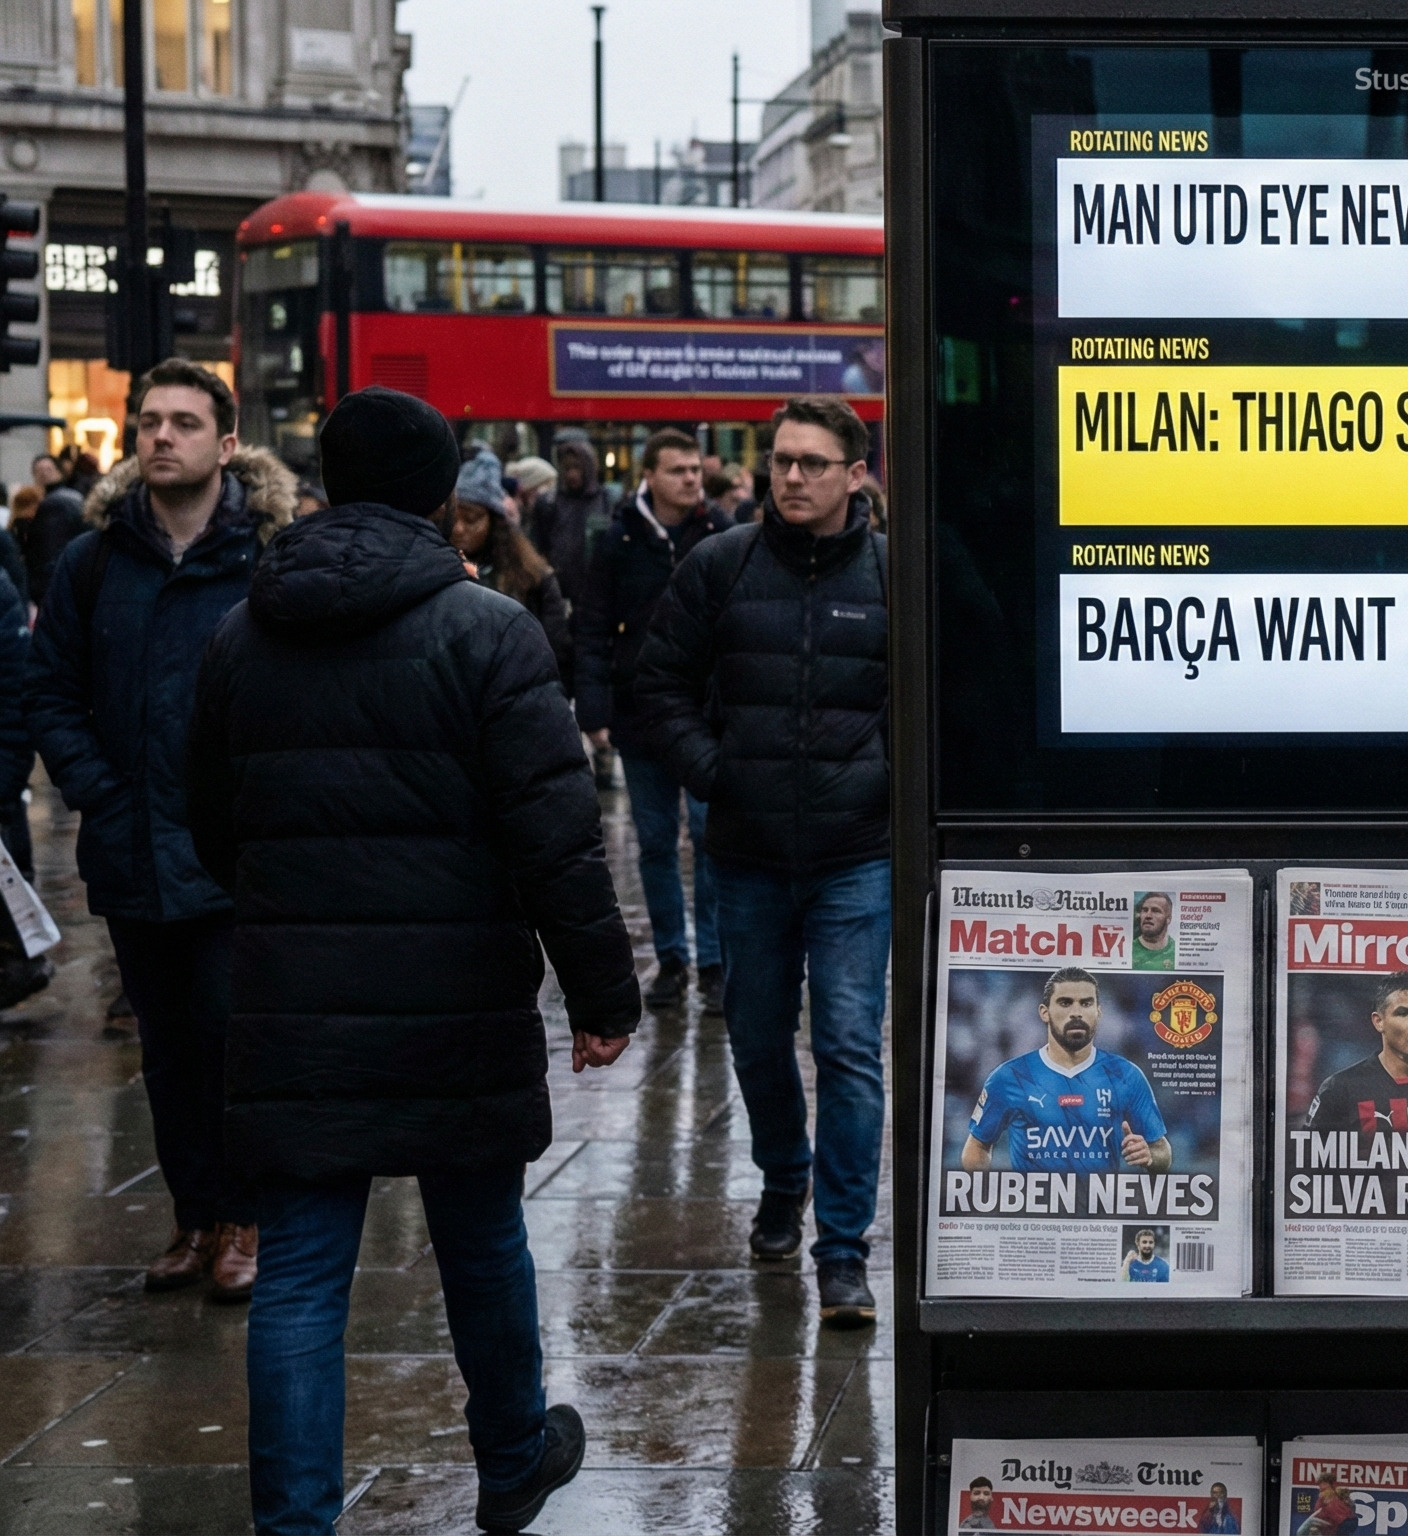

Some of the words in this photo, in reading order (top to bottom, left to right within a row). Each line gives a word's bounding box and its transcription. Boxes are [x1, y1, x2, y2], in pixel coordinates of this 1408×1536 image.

[1069, 130, 1154, 152] ROTATING
[1158, 130, 1209, 152] NEWS
[1072, 183, 1161, 246] MAN
[1173, 183, 1249, 246] UTD
[1260, 183, 1330, 246] EYE
[1070, 337, 1155, 360] ROTATING
[1159, 337, 1210, 360] NEWS
[1074, 390, 1220, 453] MILAN:
[1232, 390, 1384, 453] THIAGO
[1072, 544, 1156, 567] ROTATING
[1160, 544, 1210, 567] NEWS
[1076, 596, 1241, 681] BARÇA
[1253, 596, 1396, 662] WANT
[949, 919, 1083, 957] Match
[1026, 1125, 1114, 1149] SAVVY
[944, 1170, 1077, 1215] RUBEN
[1087, 1172, 1215, 1217] NEVES
[1289, 1174, 1387, 1215] SILVA
[1000, 1457, 1073, 1491] Daily
[1136, 1460, 1204, 1487] Time
